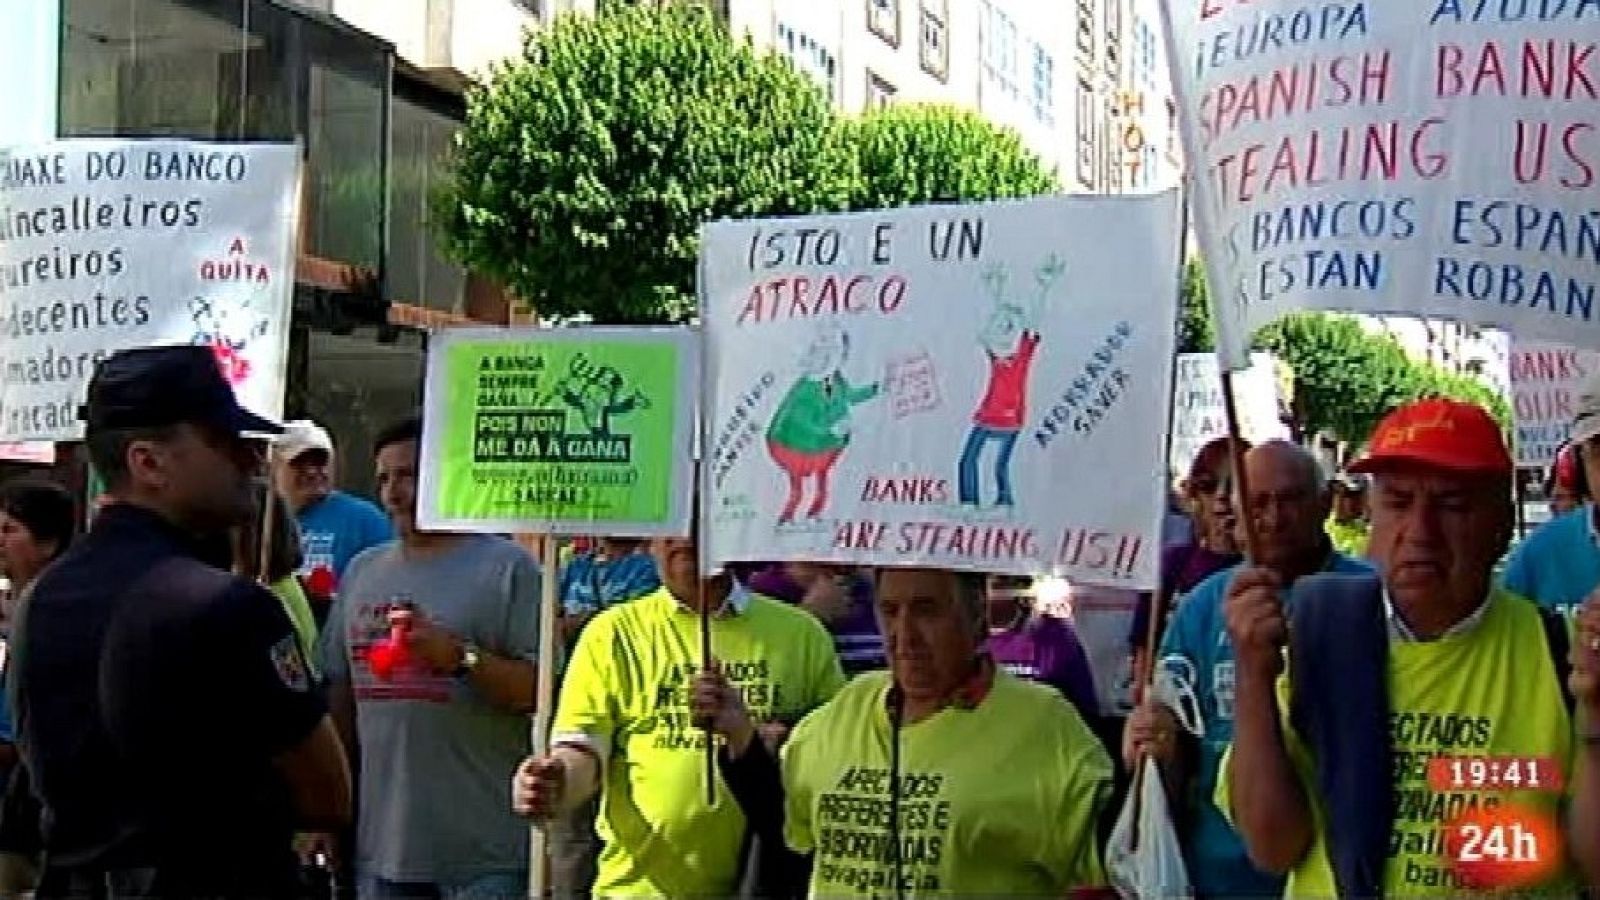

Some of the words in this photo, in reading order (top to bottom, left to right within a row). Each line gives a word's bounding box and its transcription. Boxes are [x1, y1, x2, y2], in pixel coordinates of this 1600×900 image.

[1200, 50, 1390, 146] SPANISH
[87, 151, 126, 181] DO
[145, 151, 246, 181] BANCO
[1211, 119, 1450, 206] TEALING
[1513, 120, 1595, 189] US
[229, 237, 244, 255] A
[748, 227, 840, 270] ISTO
[873, 224, 895, 266] E
[929, 218, 984, 262] UN
[1252, 200, 1415, 252] BANCOS
[736, 274, 907, 326] ATRACO
[1259, 250, 1382, 301] ESTAN
[1435, 257, 1595, 322] ROBAN
[479, 415, 518, 431] POIS
[522, 415, 563, 431] NON
[477, 438, 509, 456] ME
[567, 439, 628, 456] GANA
[860, 479, 950, 505] BANKS
[831, 519, 887, 549] ARE
[896, 522, 1041, 560] STEALING
[836, 766, 943, 799] AFECADOS
